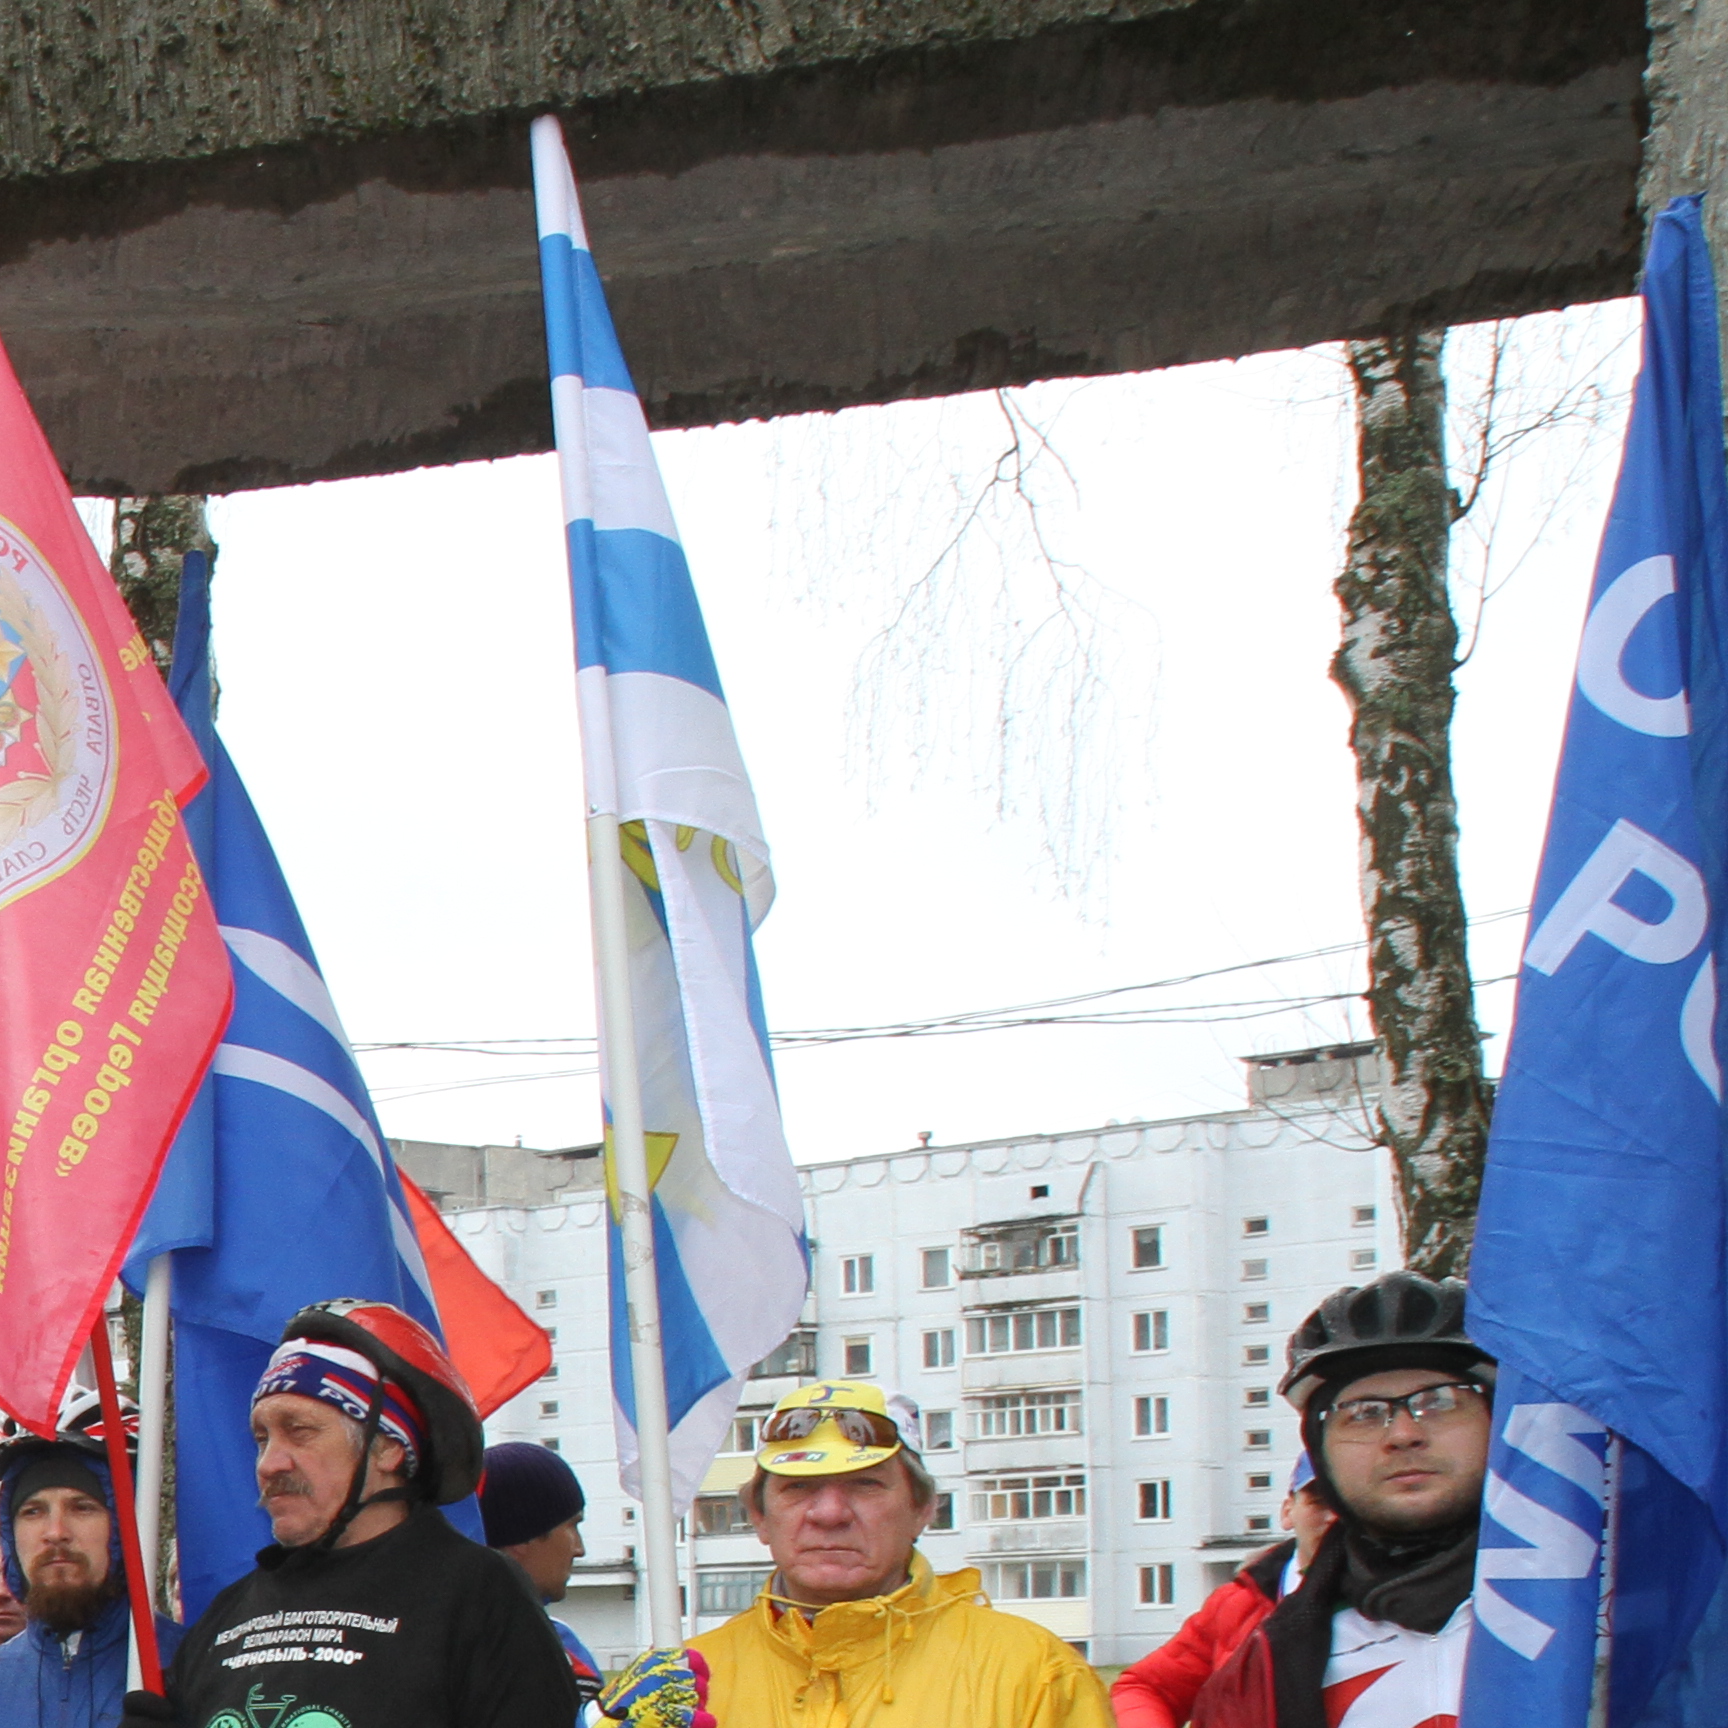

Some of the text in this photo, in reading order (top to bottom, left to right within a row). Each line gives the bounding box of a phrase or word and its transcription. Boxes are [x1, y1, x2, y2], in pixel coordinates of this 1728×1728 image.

[283, 1611, 399, 1635] БЛАГОТВОРИТЕЛЬНЫЙ
[243, 1628, 344, 1650] ВЕЛОМАРАФОН МИРА
